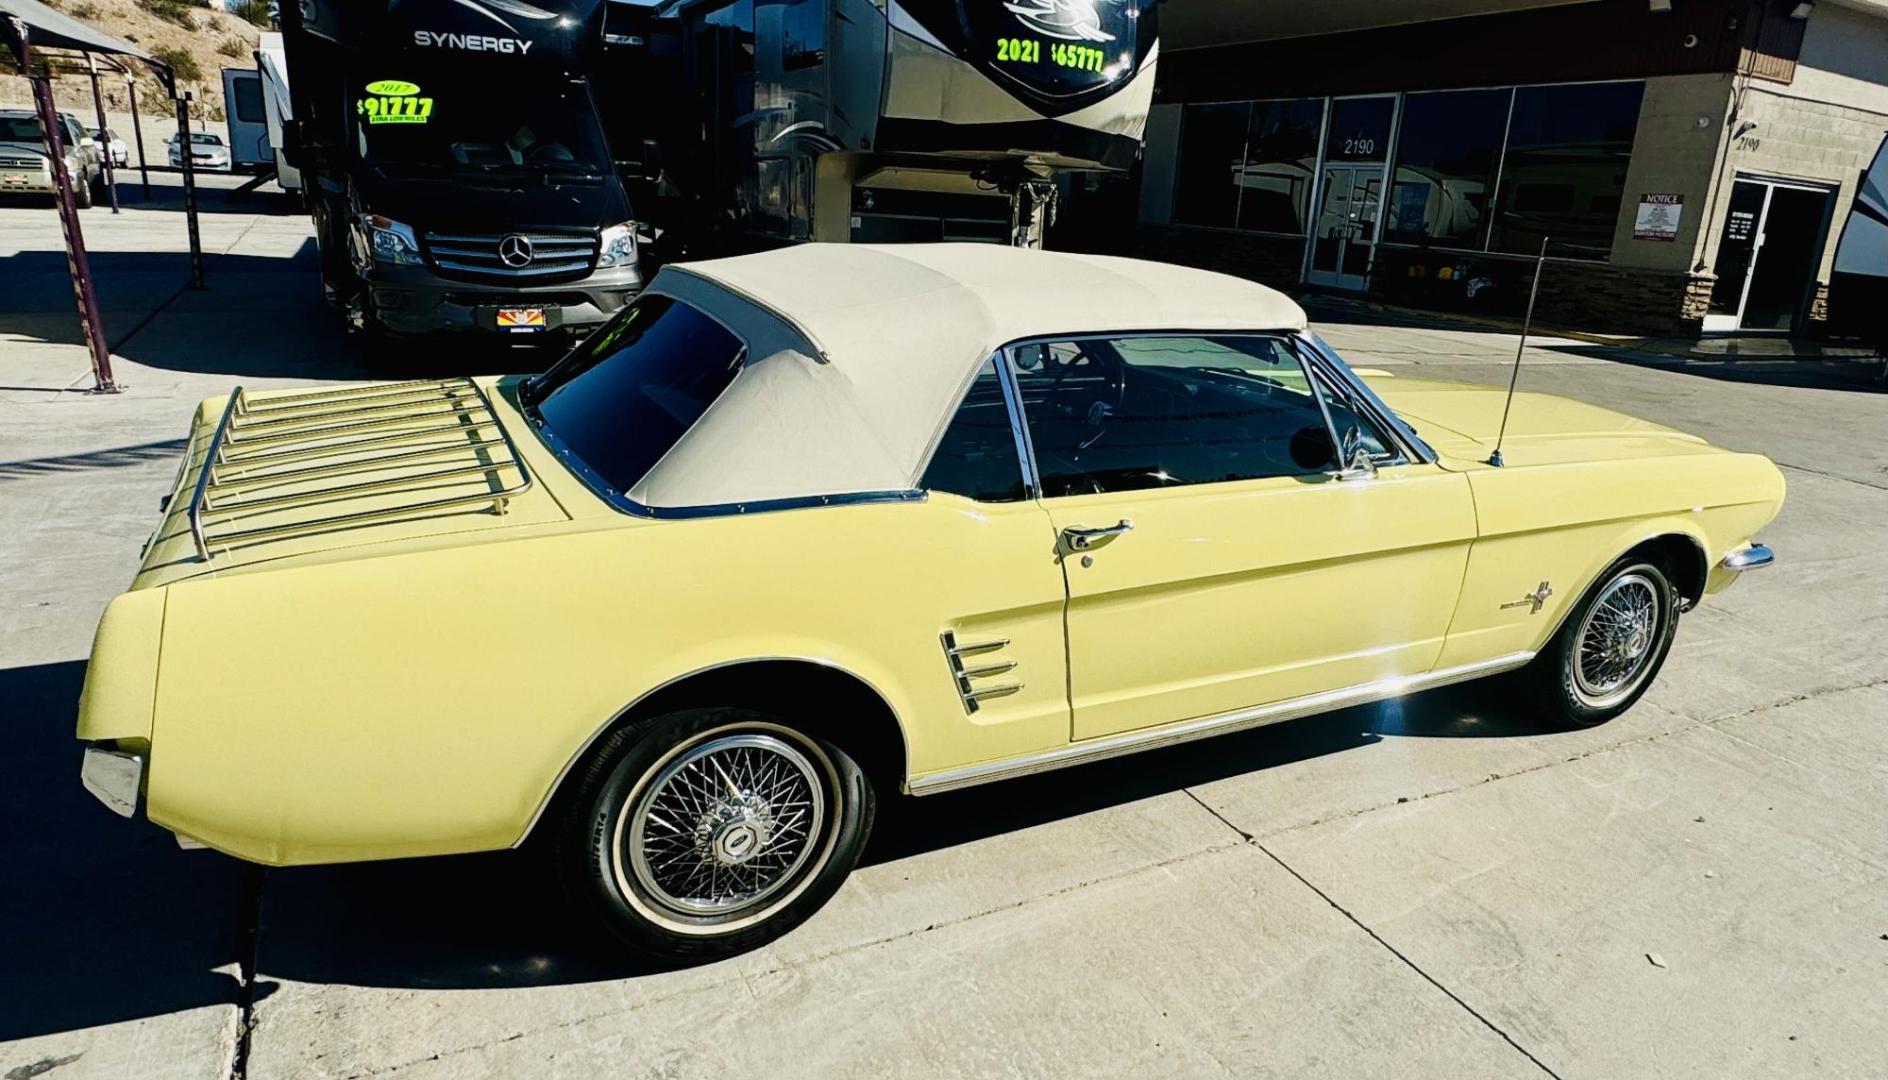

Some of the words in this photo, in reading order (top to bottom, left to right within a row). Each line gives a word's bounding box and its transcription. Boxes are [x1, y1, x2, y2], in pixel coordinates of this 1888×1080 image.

[414, 30, 533, 55] SYNERGY
[997, 38, 1039, 63] 2021
[1051, 43, 1104, 73] $65777
[375, 83, 412, 92] 2017
[357, 97, 433, 116] $91777
[1344, 139, 1374, 154] 2190
[1736, 136, 1760, 151] 2190
[1647, 194, 1679, 204] NOTICE
